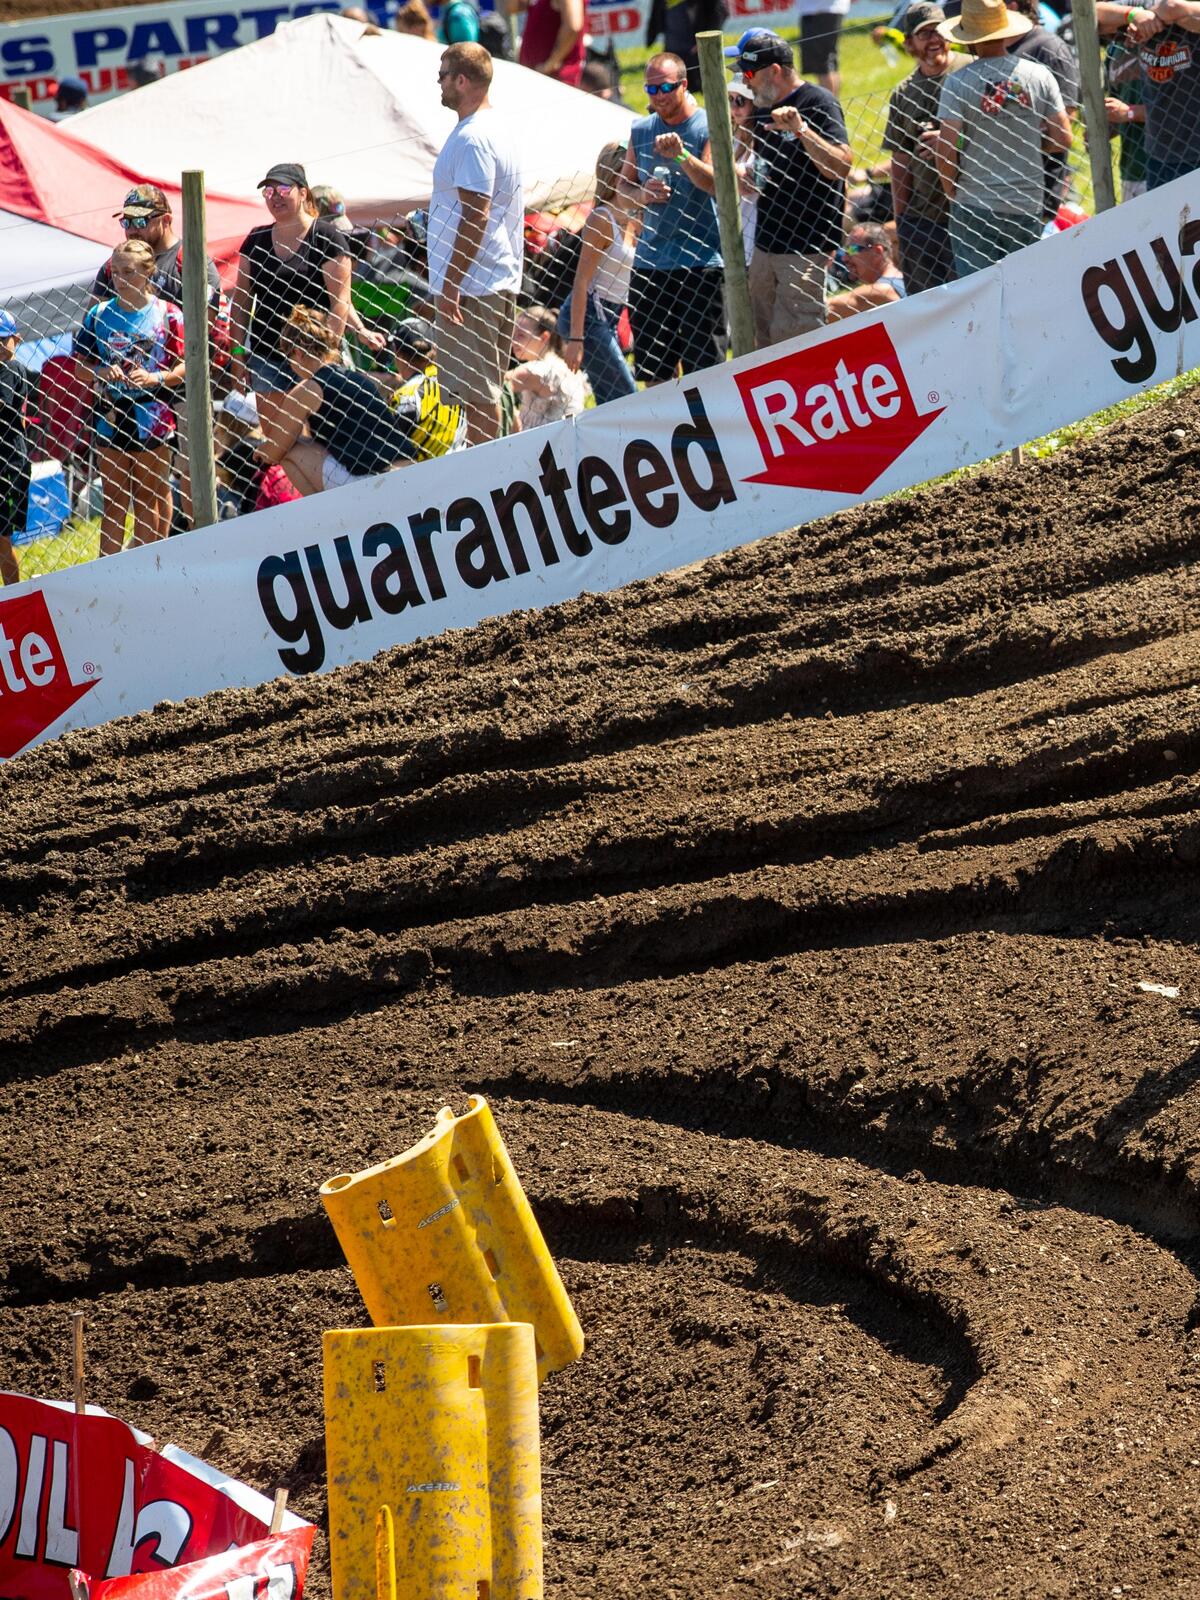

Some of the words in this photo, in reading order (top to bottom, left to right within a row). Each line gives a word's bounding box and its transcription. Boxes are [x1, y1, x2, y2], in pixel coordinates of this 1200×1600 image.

[73, 2, 341, 67] PART
[257, 387, 737, 675] guaranteed
[750, 358, 902, 457] Rate
